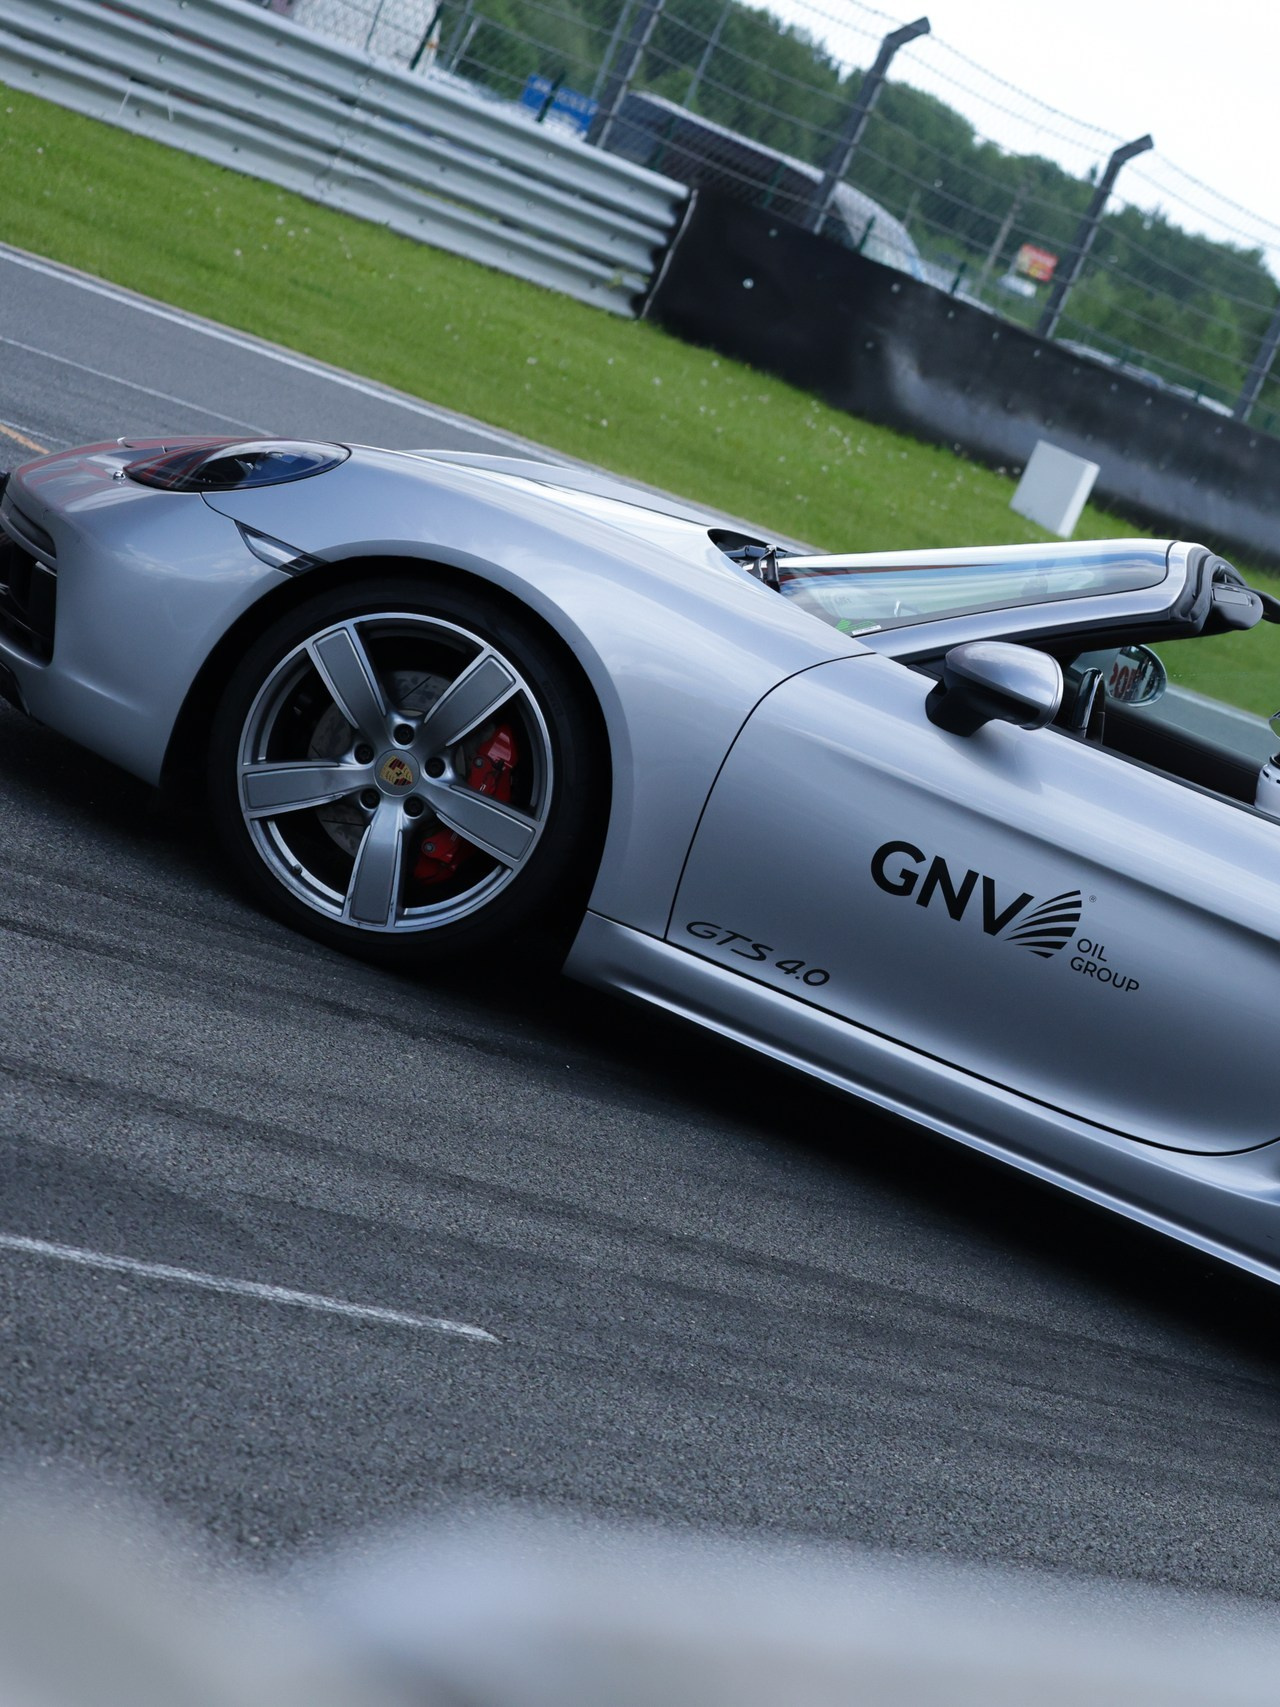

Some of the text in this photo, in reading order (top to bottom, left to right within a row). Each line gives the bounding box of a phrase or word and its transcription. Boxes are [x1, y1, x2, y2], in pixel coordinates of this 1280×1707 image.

[870, 840, 1034, 936] GNV
[686, 921, 830, 986] GTS 4.0
[1070, 956, 1140, 992] GROUP
[1077, 938, 1107, 962] OIL
